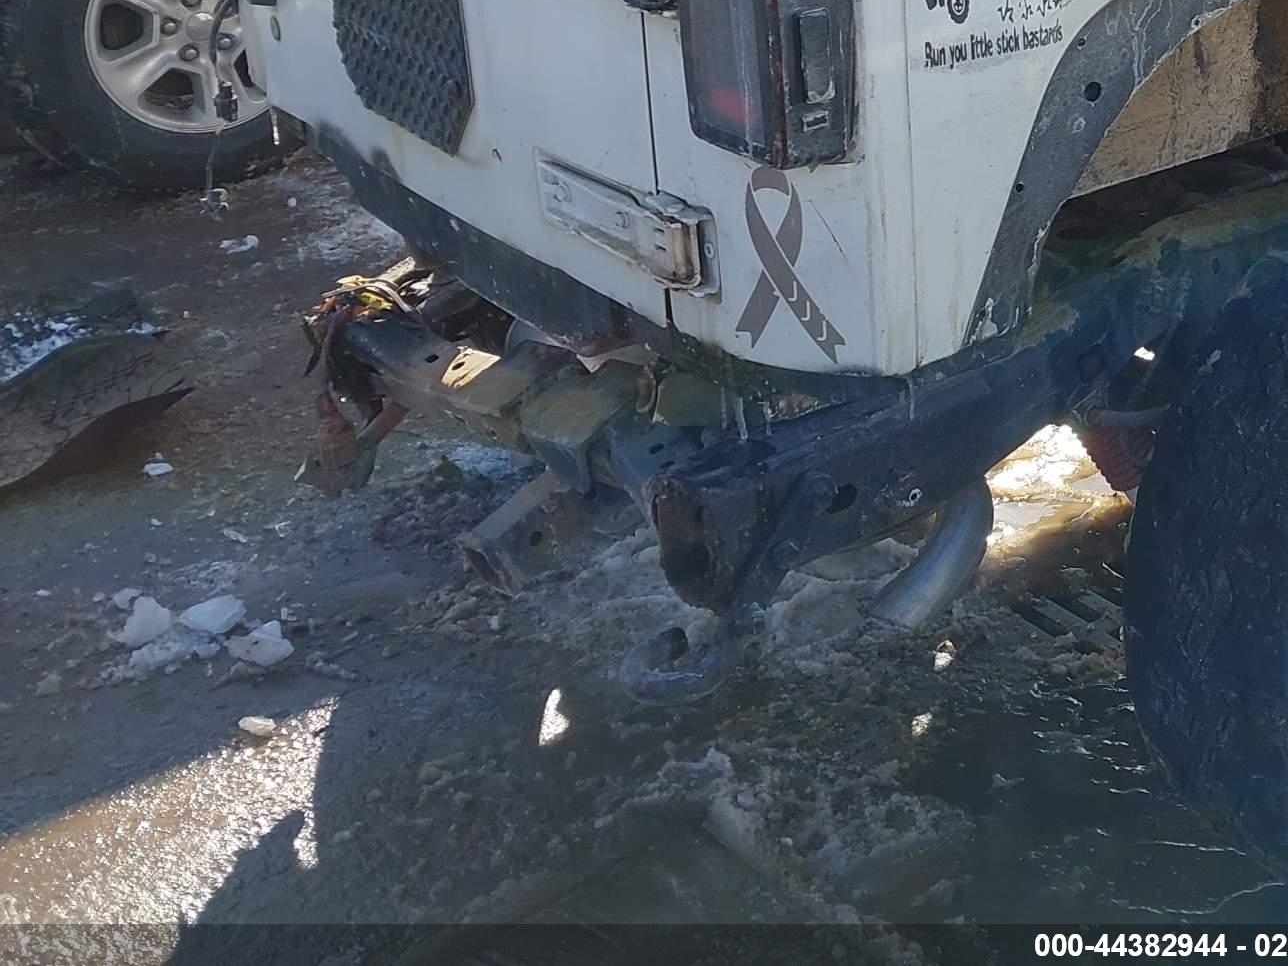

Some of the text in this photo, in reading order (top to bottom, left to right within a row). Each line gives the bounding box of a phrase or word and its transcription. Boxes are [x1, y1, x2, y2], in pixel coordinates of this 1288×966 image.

[924, 41, 946, 67] Run
[949, 41, 967, 69] you
[996, 26, 1020, 55] stick
[1023, 19, 1062, 48] bastards
